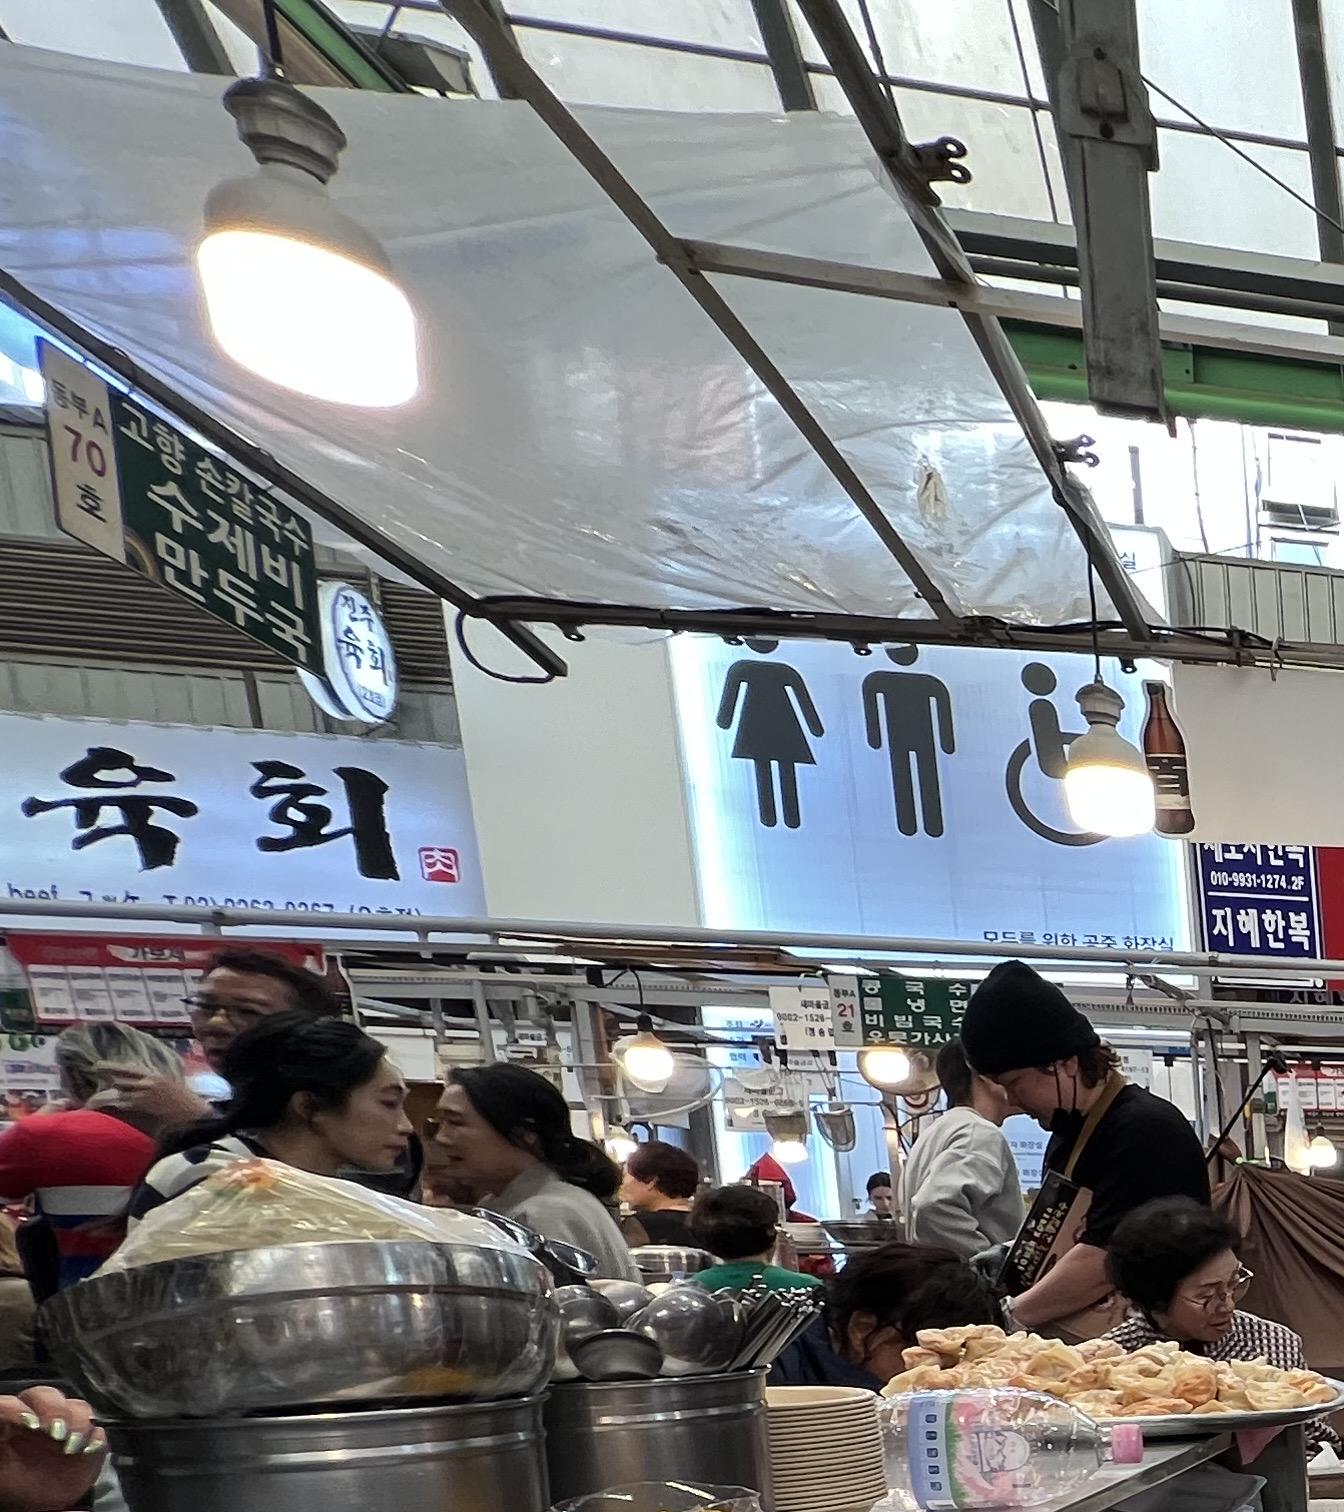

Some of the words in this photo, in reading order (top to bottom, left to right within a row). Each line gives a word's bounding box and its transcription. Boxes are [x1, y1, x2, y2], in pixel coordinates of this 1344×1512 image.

[63, 424, 106, 477] 70
[75, 482, 107, 524] 호
[119, 401, 186, 476] 고향
[194, 456, 310, 556] 손칼국수
[147, 480, 305, 611] 수제비
[154, 530, 312, 664] 만두국
[22, 745, 401, 881] 육회
[1211, 907, 1311, 951] 지혜한복
[836, 1003, 855, 1017] 21
[866, 1030, 960, 1046] 우뭇가사
